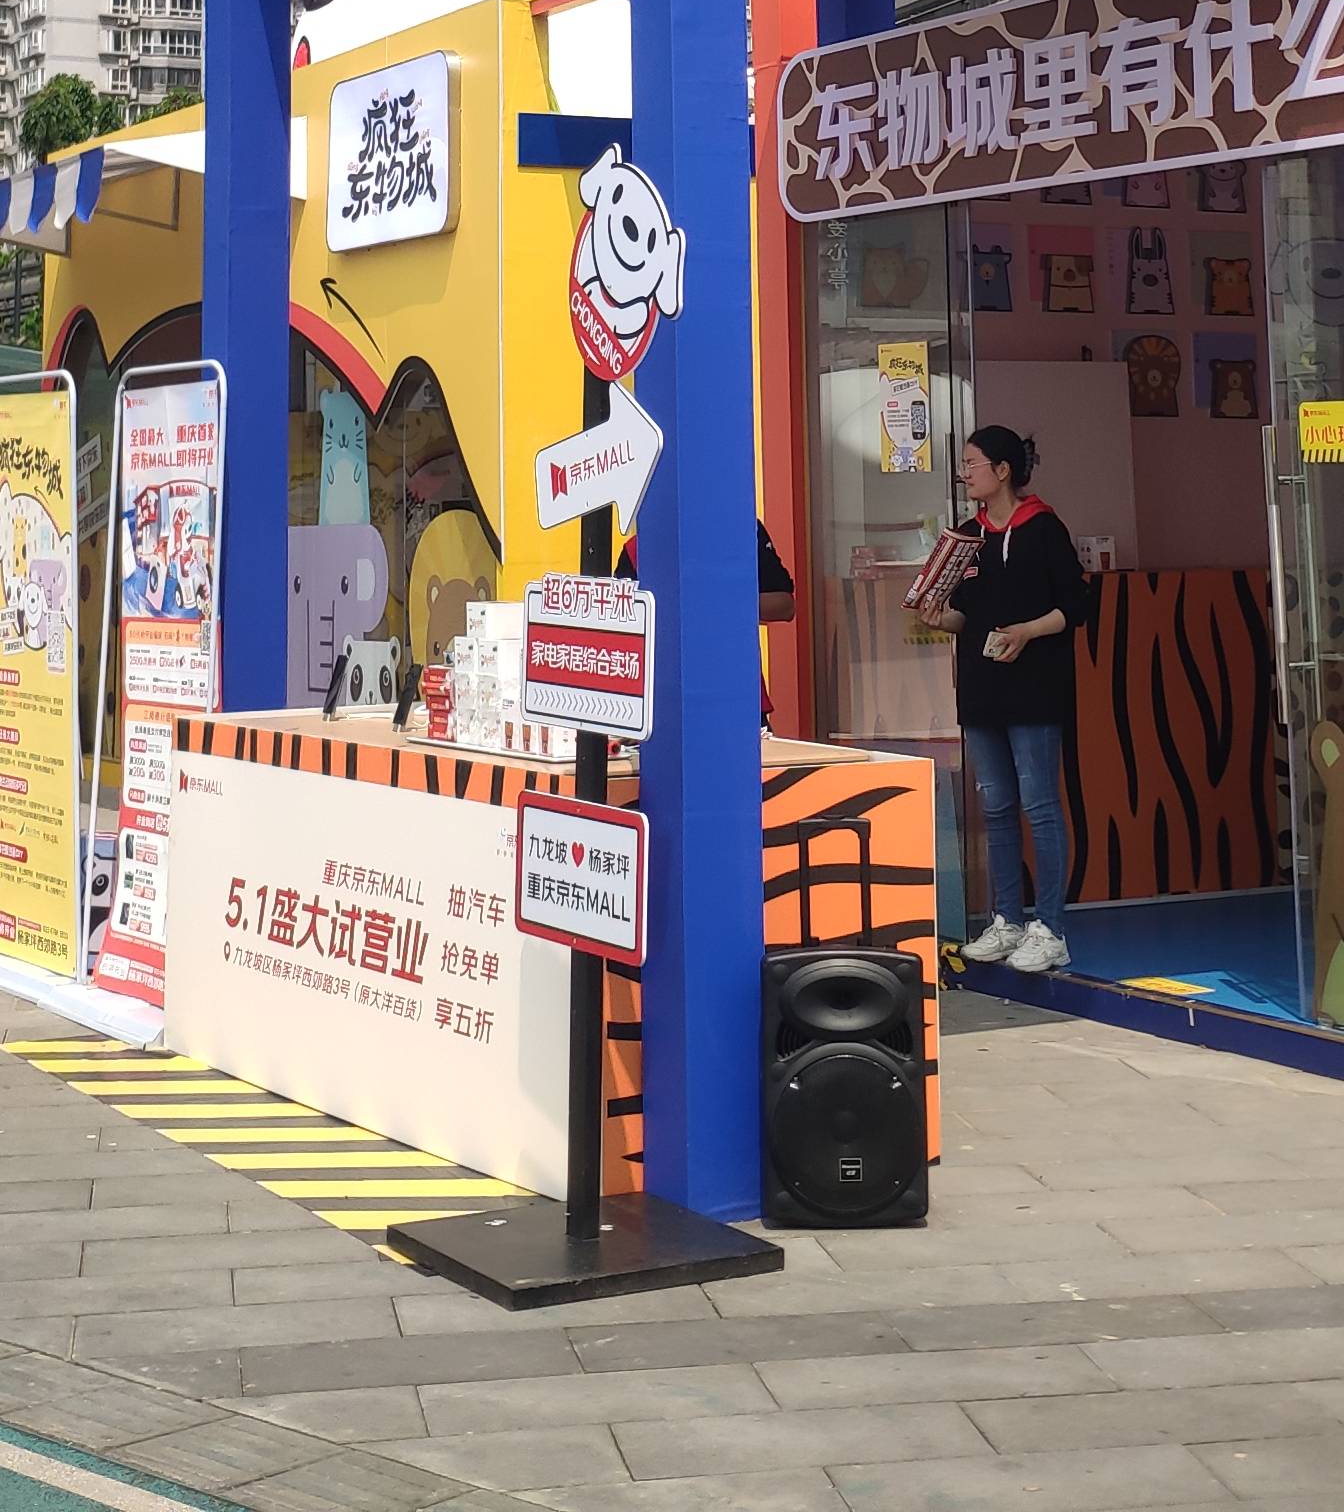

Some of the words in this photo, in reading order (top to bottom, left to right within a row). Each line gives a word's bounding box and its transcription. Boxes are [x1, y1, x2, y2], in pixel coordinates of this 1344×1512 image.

[358, 89, 419, 163] 疯狂
[342, 140, 437, 223] 东物城
[570, 291, 624, 375] CHONGQING
[569, 439, 635, 487] 京东MALL
[543, 578, 637, 622] 超6万平米
[531, 640, 640, 680] 家电家居综合卖场
[189, 775, 223, 796] 京东MALL
[528, 832, 568, 865] 九龙坡
[588, 846, 630, 880] 杨家坪
[323, 858, 425, 907] 重庆京东MALL
[447, 883, 507, 929] 抽汽车
[527, 872, 632, 924] 重庆京东MALL
[224, 876, 429, 985] 5.1盛大试营业
[441, 940, 501, 986] 抢免单
[434, 997, 495, 1044] 享五折
